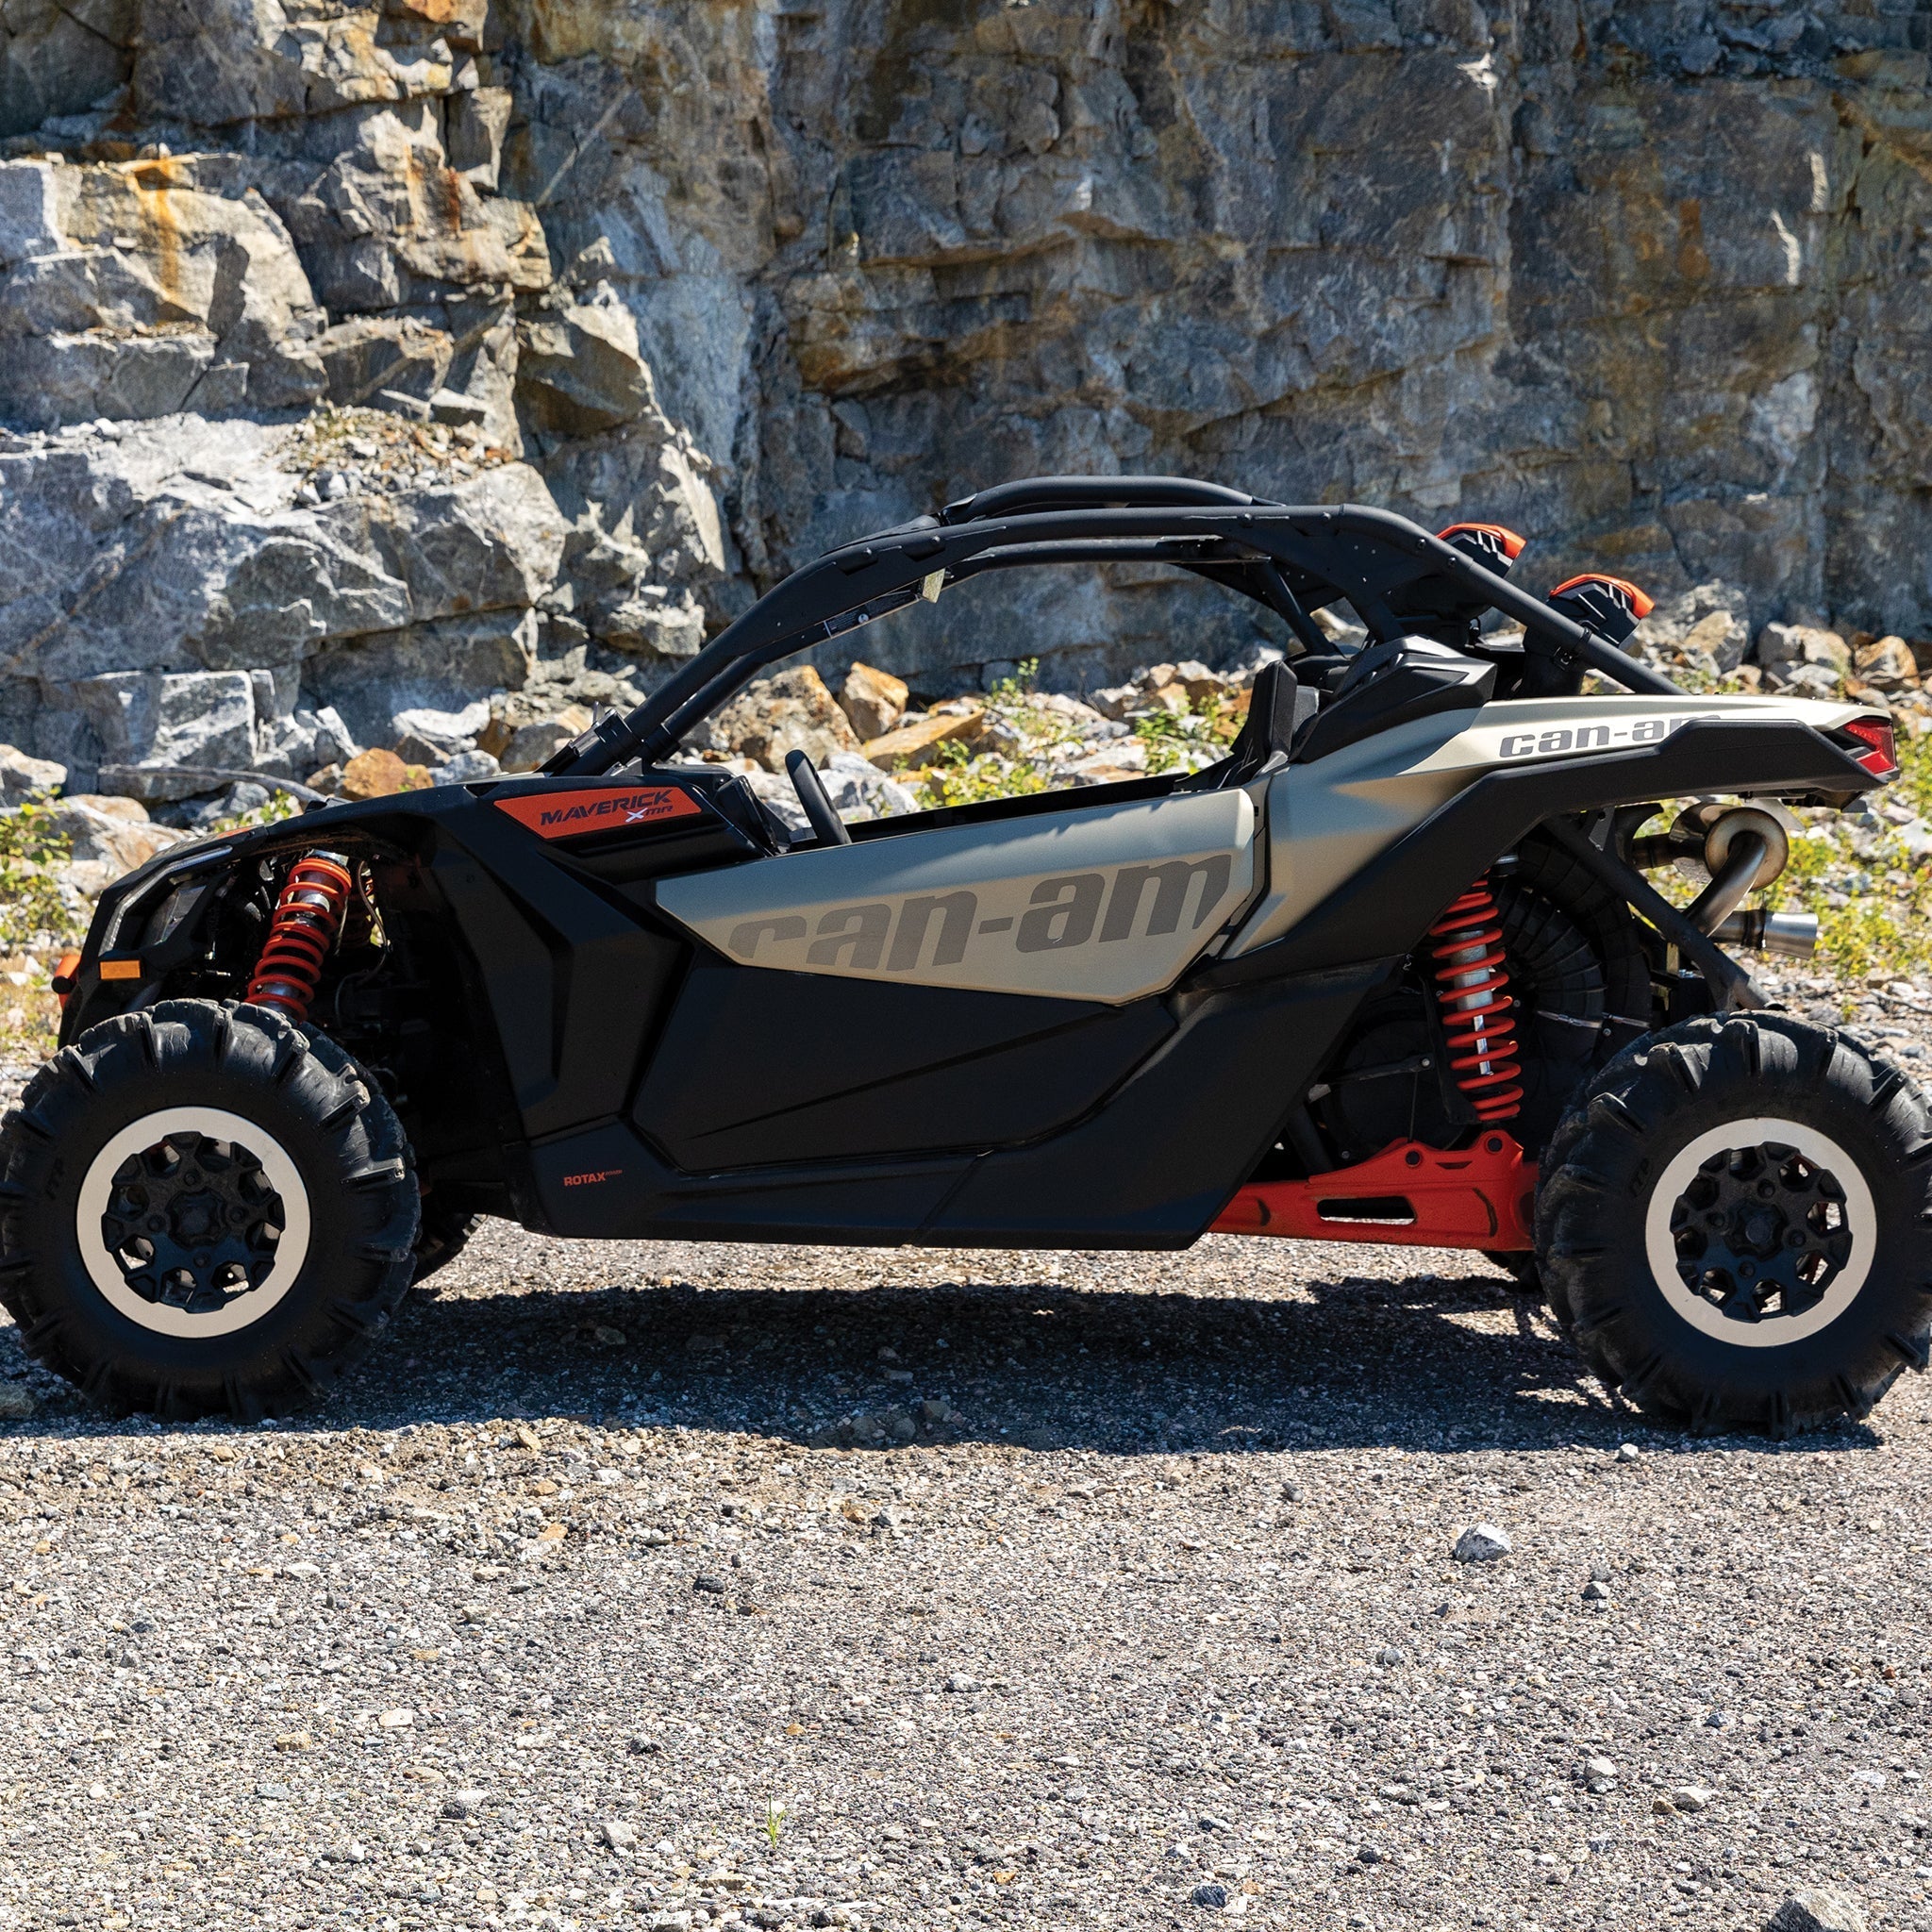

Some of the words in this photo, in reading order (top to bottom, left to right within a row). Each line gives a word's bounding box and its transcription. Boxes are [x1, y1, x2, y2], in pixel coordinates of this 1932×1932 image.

[541, 789, 674, 825] MAVERICK
[727, 854, 1232, 973] can-am
[563, 1172, 606, 1187] ROTAX
